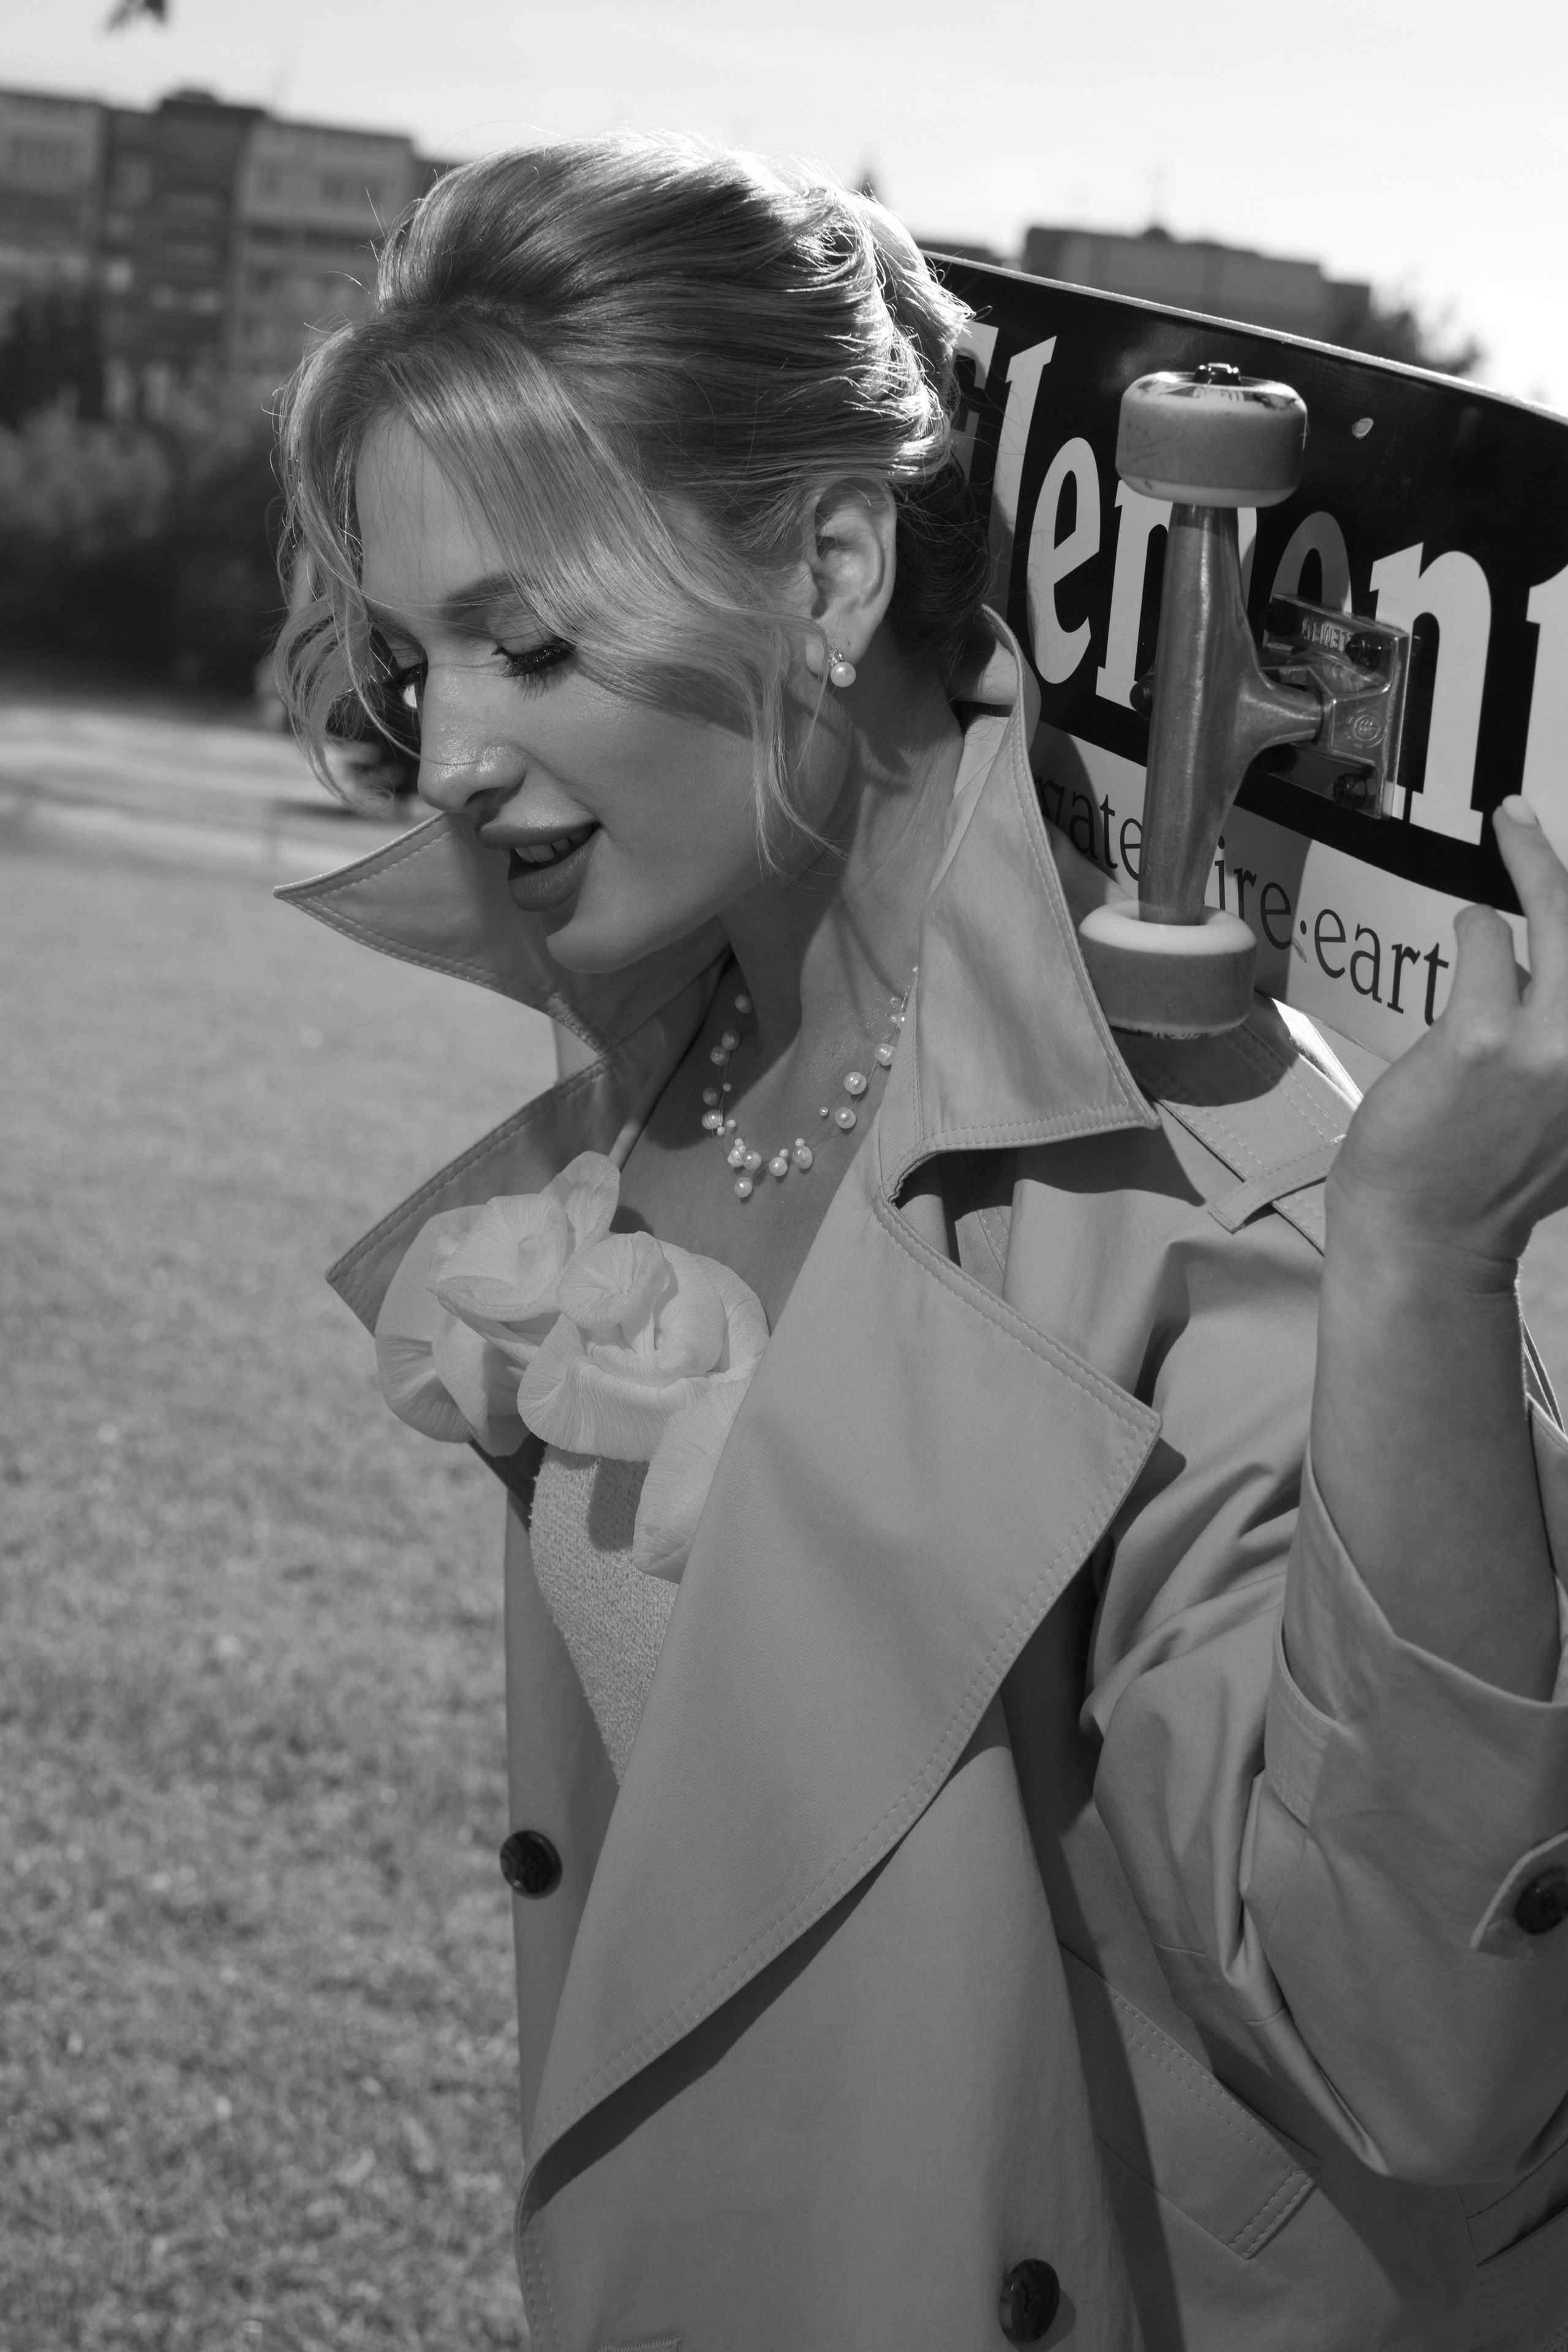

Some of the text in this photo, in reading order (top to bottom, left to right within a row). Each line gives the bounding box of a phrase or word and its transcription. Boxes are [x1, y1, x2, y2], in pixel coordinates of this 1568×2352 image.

[1035, 775, 1450, 1028] ate ire eart
